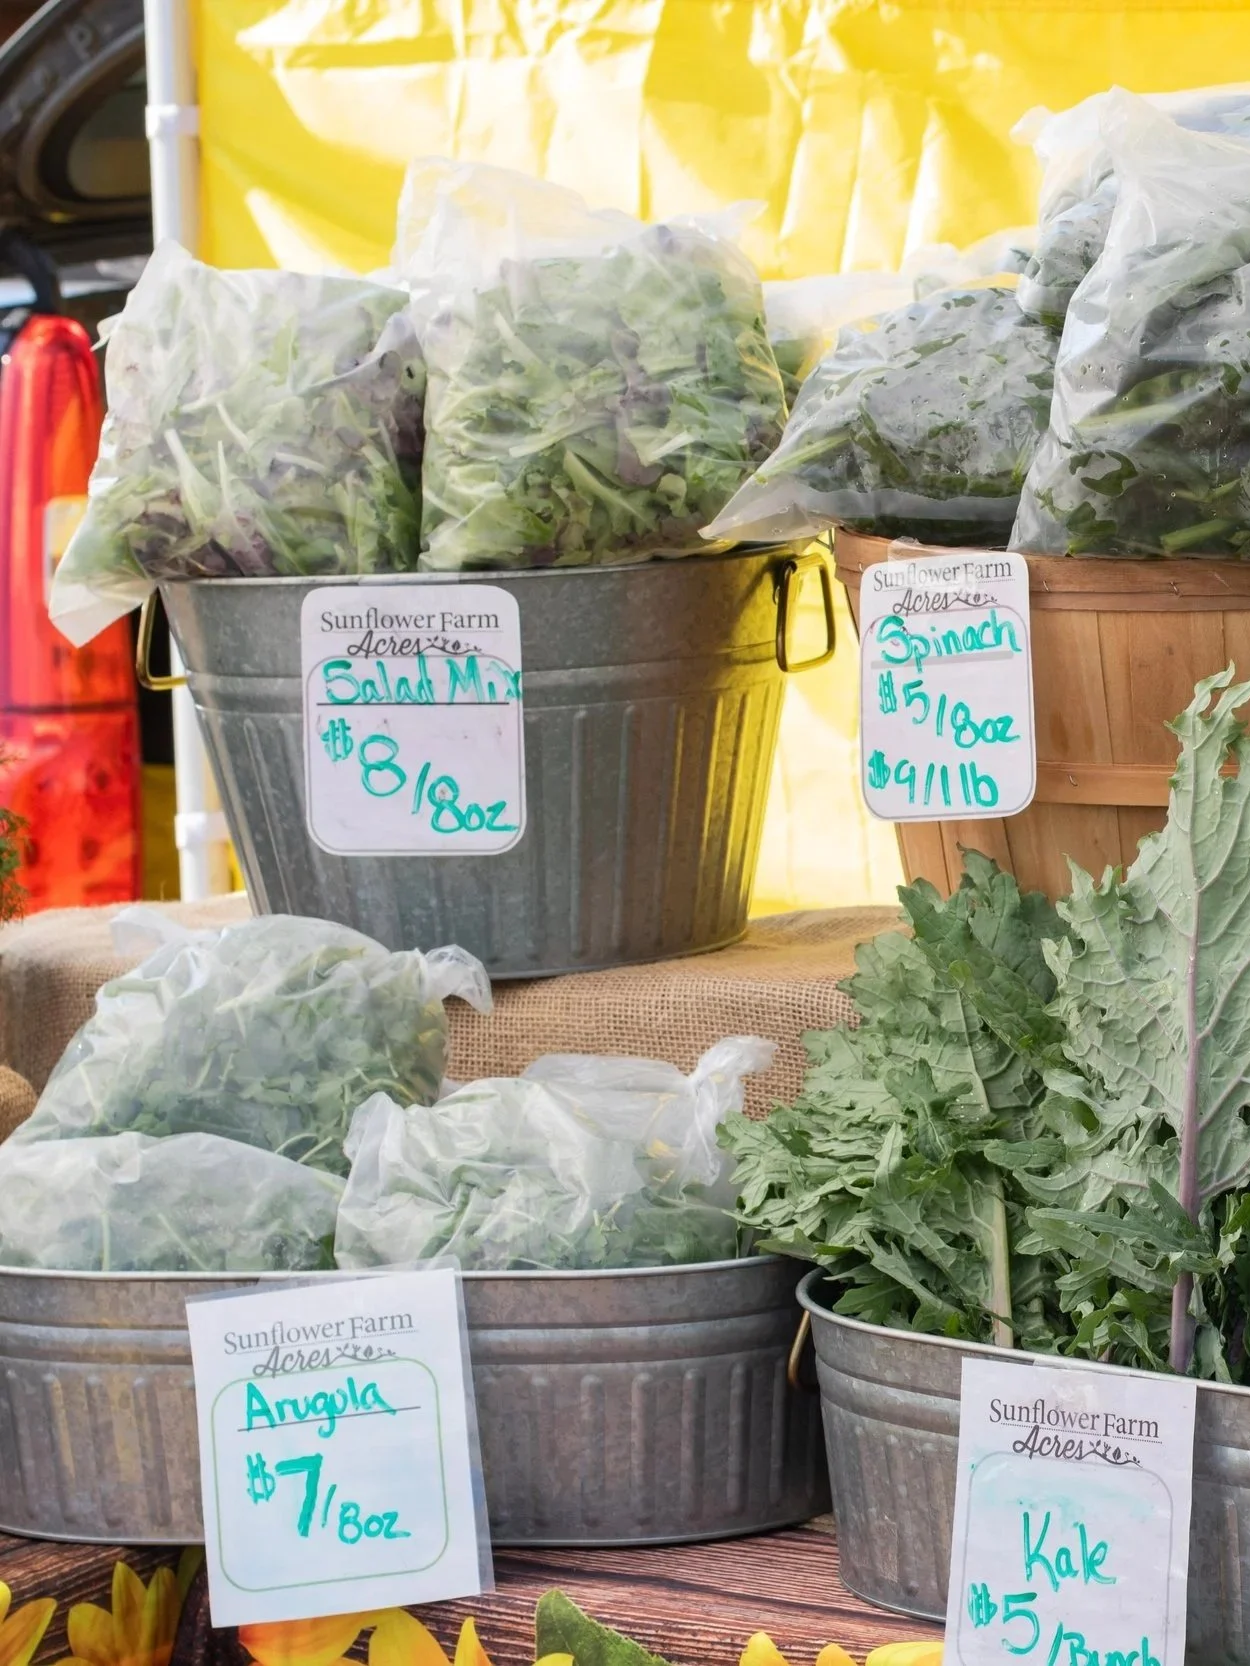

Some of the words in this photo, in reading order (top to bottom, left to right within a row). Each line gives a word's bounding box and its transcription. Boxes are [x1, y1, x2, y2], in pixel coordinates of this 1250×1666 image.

[873, 562, 960, 591] Sunflower
[963, 560, 1013, 582] Farm
[320, 607, 435, 632] Sunflower
[440, 611, 499, 632] Farm
[892, 590, 949, 616] Acres
[347, 630, 422, 658] Acres
[877, 609, 1022, 673] Spinach
[322, 654, 434, 704] Salad
[446, 655, 522, 703] Mix
[224, 1321, 344, 1355] Sunflower
[348, 1313, 413, 1339] Farm
[253, 1346, 331, 1379] Acres
[246, 1377, 396, 1438] Arugula
[989, 1398, 1100, 1431] Sunflower
[1103, 1412, 1159, 1438] Farm
[1013, 1425, 1084, 1460] Acres
[1023, 1511, 1117, 1592] Kale
